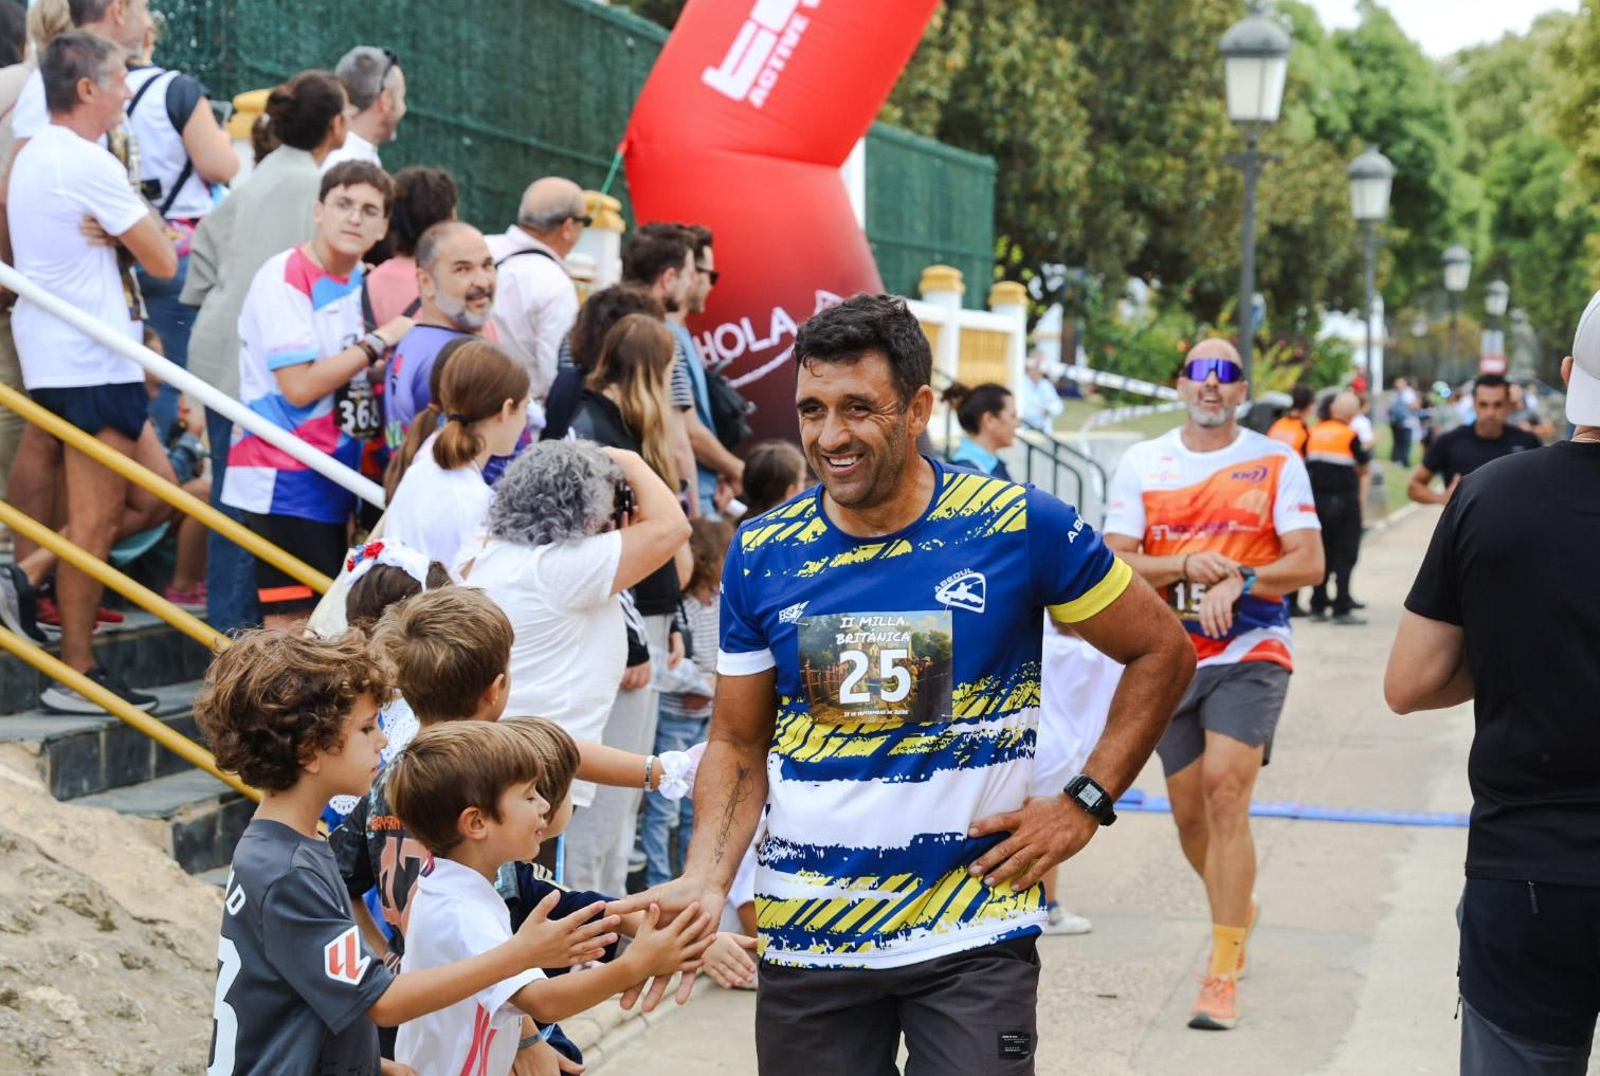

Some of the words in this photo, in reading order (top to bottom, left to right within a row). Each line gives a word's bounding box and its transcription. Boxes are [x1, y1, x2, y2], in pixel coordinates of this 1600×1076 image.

[693, 306, 799, 367] HOLA
[835, 627, 911, 645] BRITÁNICA
[839, 617, 853, 629] II
[859, 616, 906, 627] MILLA
[839, 649, 912, 704] 25
